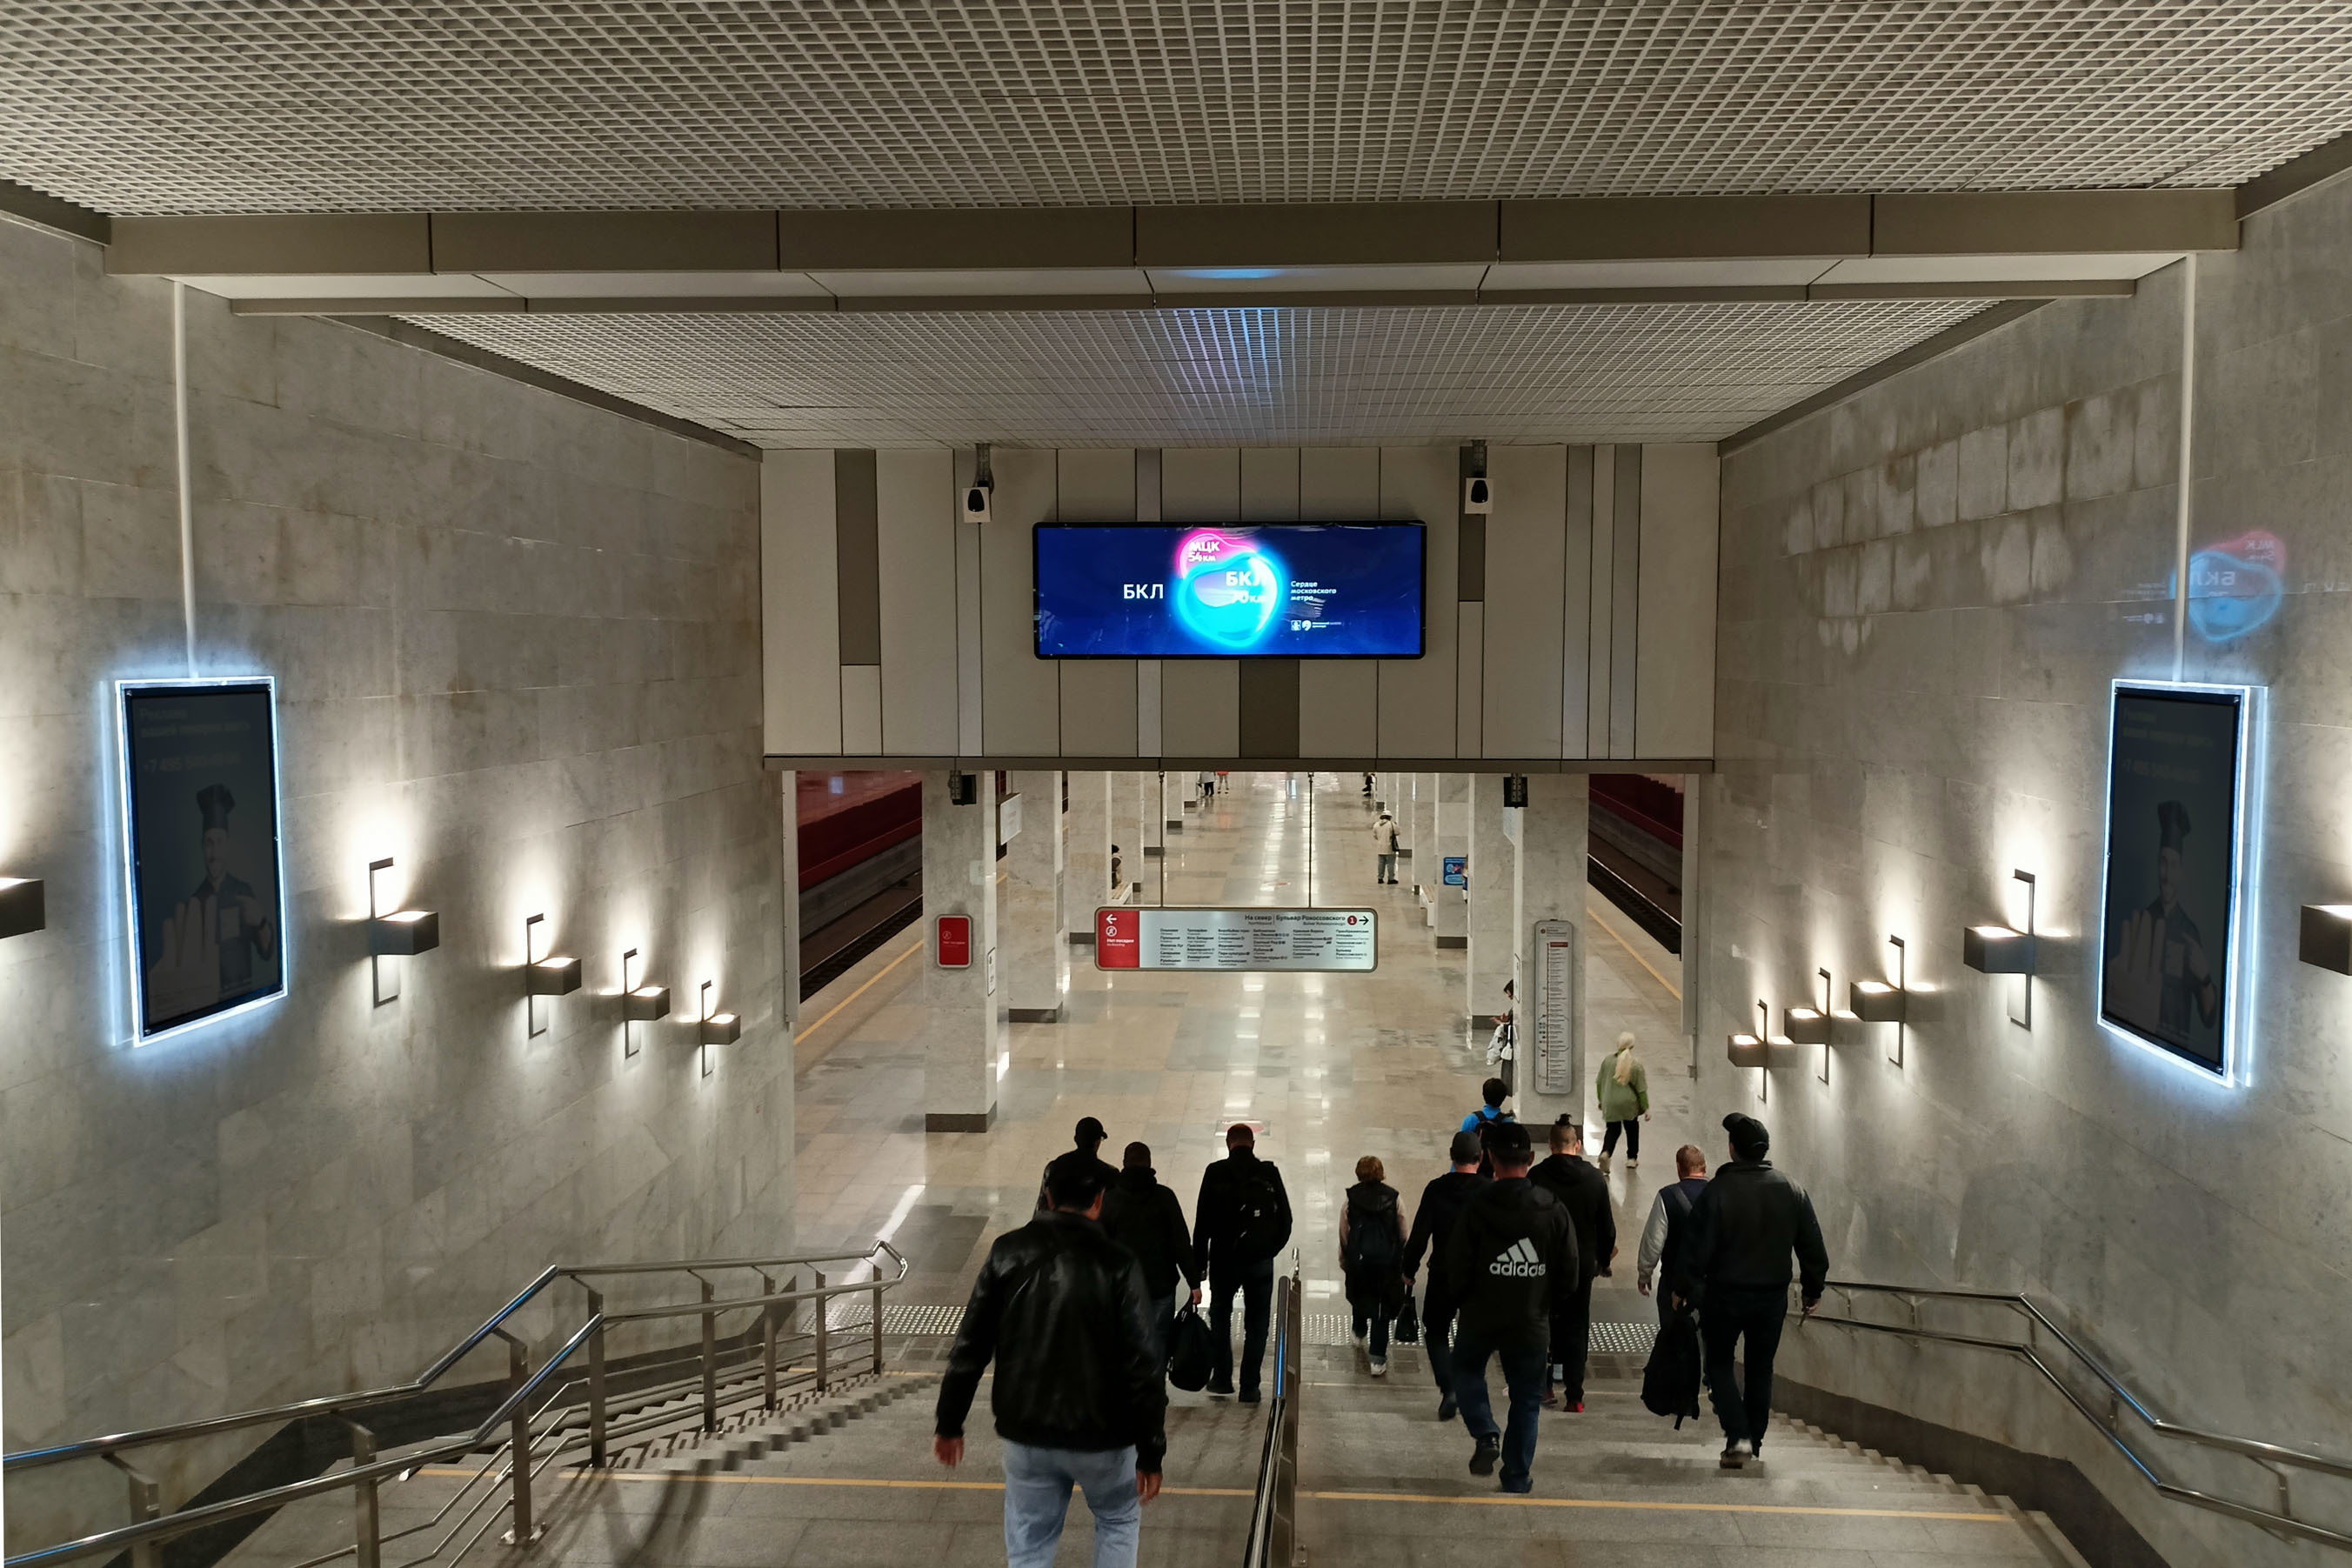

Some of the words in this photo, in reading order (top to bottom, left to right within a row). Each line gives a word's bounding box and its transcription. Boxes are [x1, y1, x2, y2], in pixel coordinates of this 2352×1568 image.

[1188, 541, 1220, 553] МЦК
[1188, 551, 1203, 562] 54
[1226, 571, 1266, 586] БКЛ
[1124, 584, 1164, 599] БКЛ
[1489, 1260, 1546, 1277] adidas
